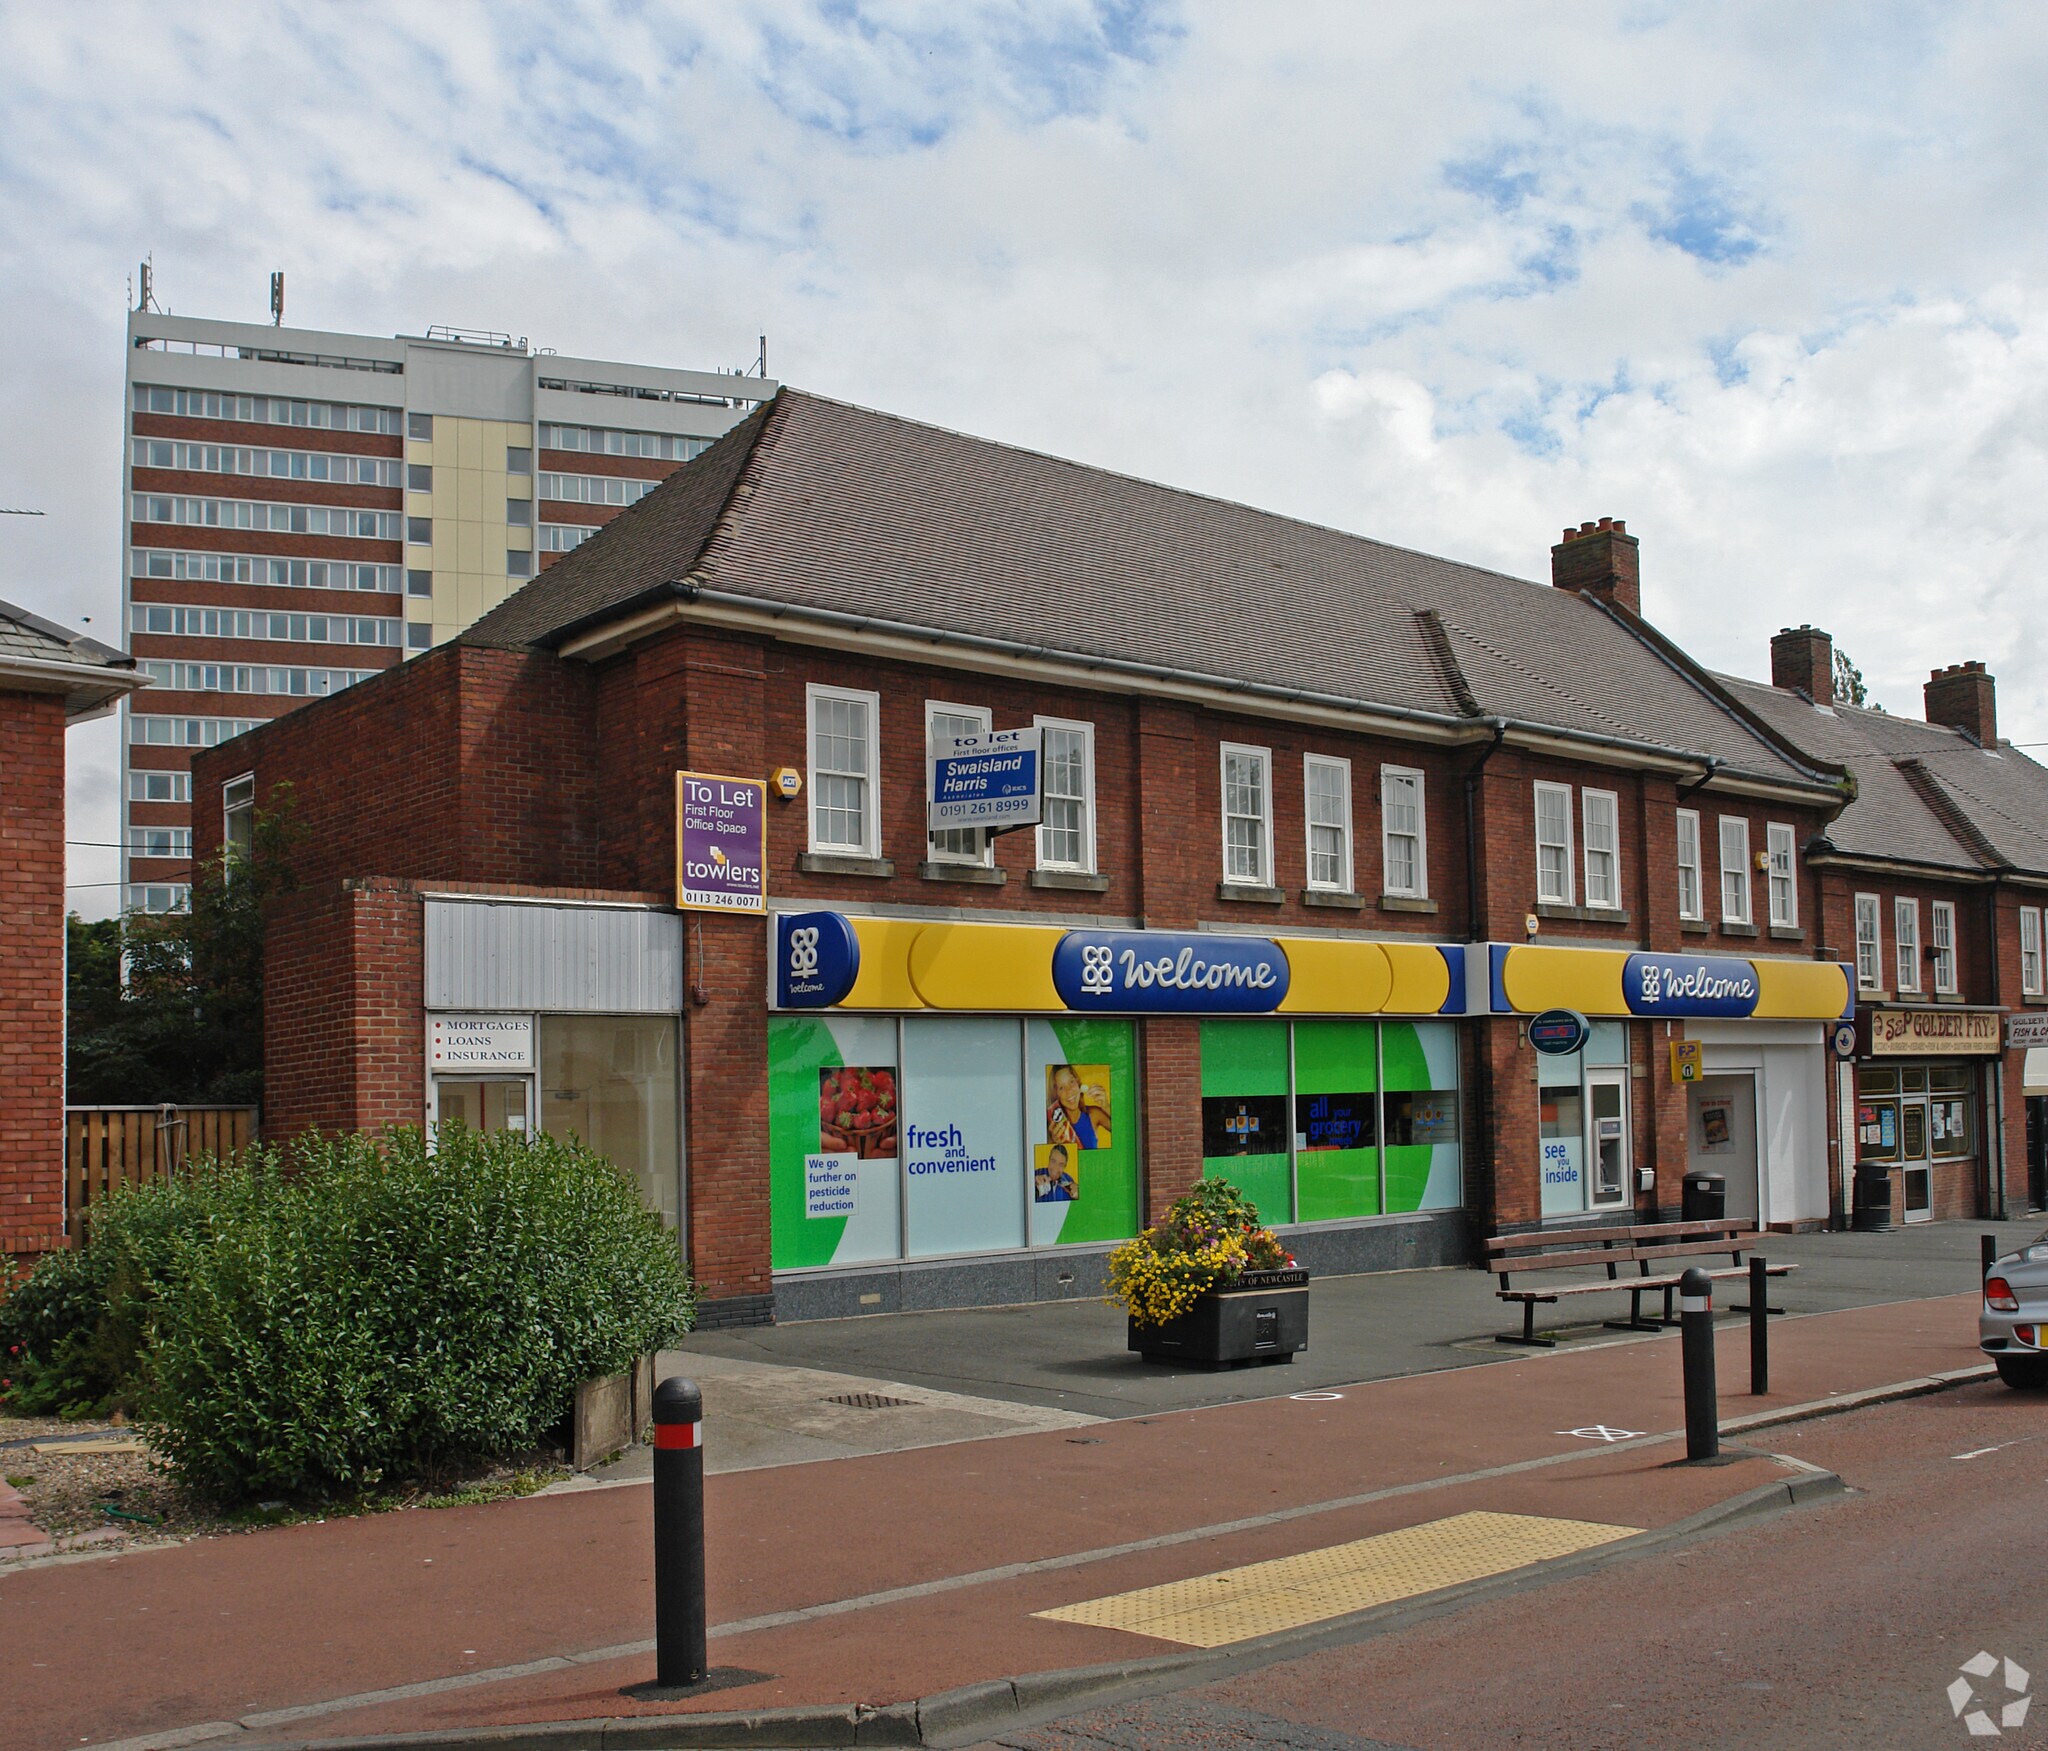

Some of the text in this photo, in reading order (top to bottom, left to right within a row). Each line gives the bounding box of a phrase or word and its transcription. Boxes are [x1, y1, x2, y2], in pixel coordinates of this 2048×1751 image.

[953, 732, 1020, 747] to let
[953, 744, 1018, 757] First floor offices
[947, 756, 1022, 776] Swaisland
[943, 776, 988, 793] Harris
[685, 780, 754, 808] To Let
[685, 803, 735, 819] First Floor
[940, 799, 1029, 817] 0191 261 8999
[685, 818, 747, 835] Office Space
[685, 859, 760, 883] towlers
[686, 892, 760, 907] 0113 246 0071
[447, 1021, 529, 1031] MORTGAGES
[1913, 1014, 1963, 1038] GOLDEN
[1965, 1013, 1990, 1038] FRY
[2013, 1027, 2031, 1037] FISH
[2031, 1027, 2038, 1036] &
[447, 1036, 492, 1046] LOANS
[447, 1051, 525, 1060] INSURANCE
[1310, 1096, 1352, 1121] all your
[906, 1123, 962, 1149] fresh
[1310, 1119, 1361, 1140] grocery
[944, 1145, 966, 1158] and
[1544, 1145, 1566, 1159] see
[808, 1159, 839, 1170] We go
[908, 1155, 996, 1175] convenient
[1557, 1158, 1570, 1169] you
[809, 1172, 857, 1183] further on
[1545, 1166, 1578, 1183] inside
[809, 1185, 851, 1199] pesticide
[809, 1200, 854, 1211] reduction
[1248, 1277, 1258, 1286] OF
[1260, 1273, 1304, 1285] NEWCASTLE
